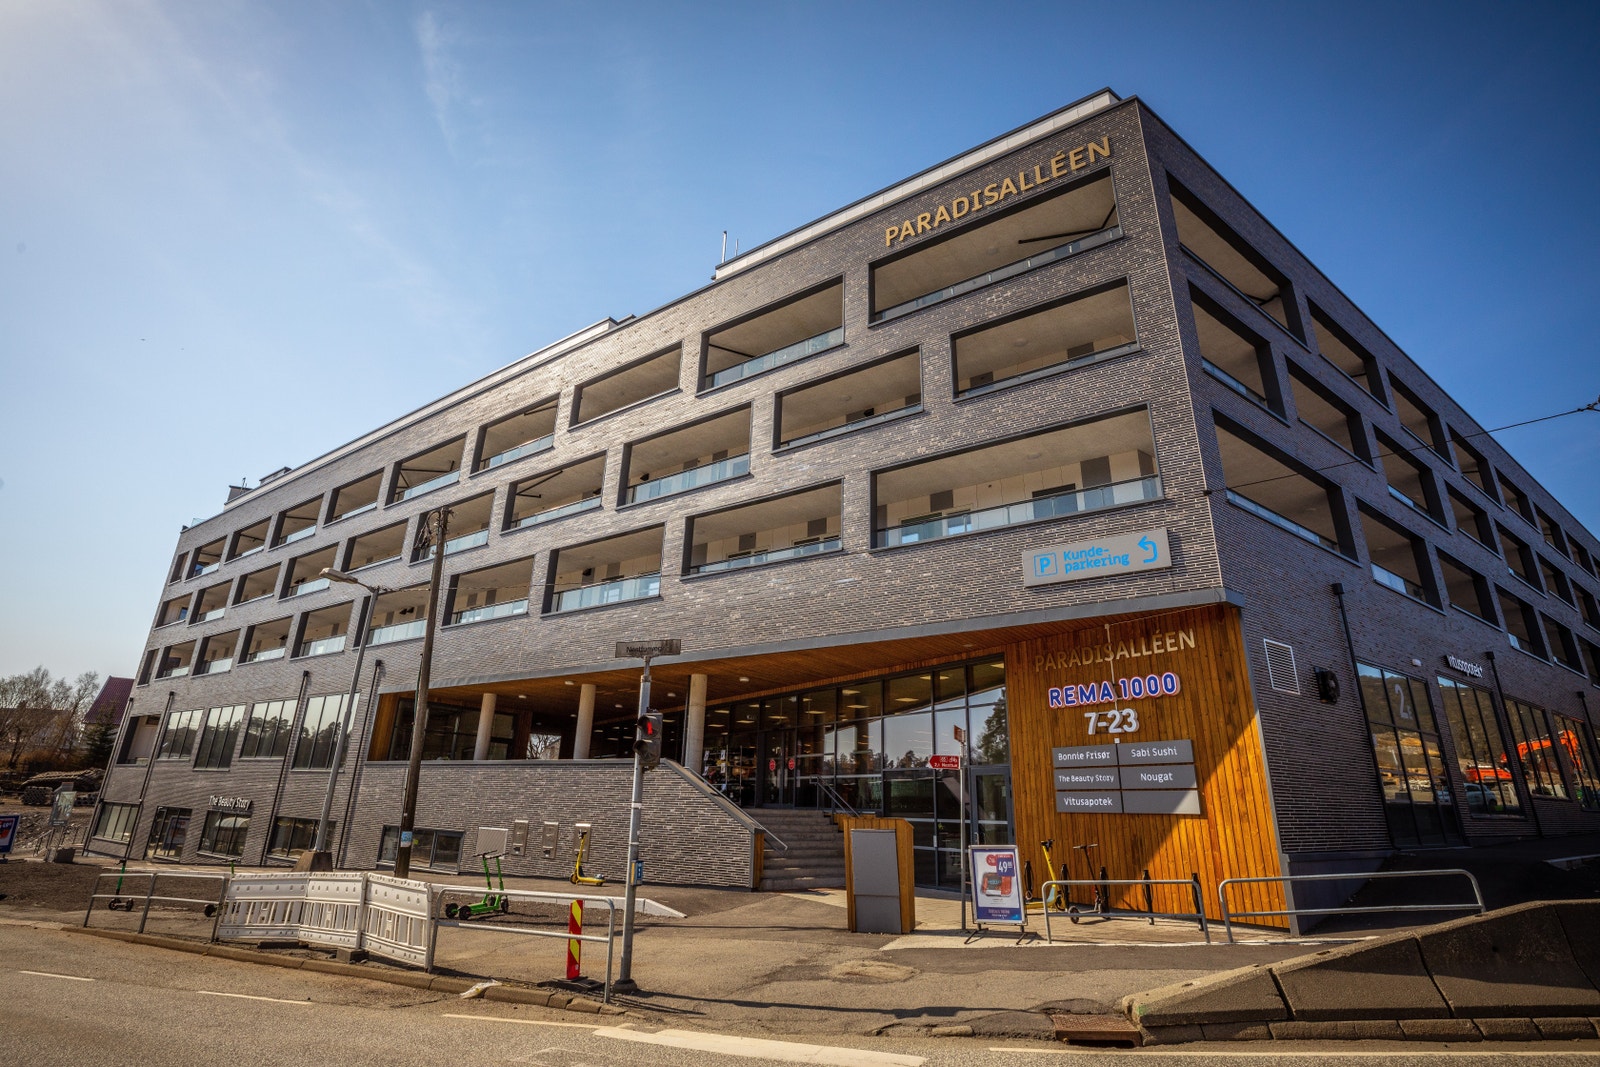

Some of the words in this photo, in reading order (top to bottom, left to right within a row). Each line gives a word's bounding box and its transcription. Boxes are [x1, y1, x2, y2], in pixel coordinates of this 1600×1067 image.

[885, 135, 1111, 247] PARADISALLÉEN
[1063, 546, 1110, 562] Kunde-
[1039, 557, 1051, 573] P
[1065, 553, 1130, 574] parkering
[1034, 628, 1196, 672] PARADISALLÉEN
[1048, 680, 1115, 709] REMA
[1118, 671, 1180, 700] 1000
[1084, 708, 1140, 735] 7-23
[1058, 752, 1084, 761] Bonnie
[1086, 751, 1110, 760] Frisør
[1131, 748, 1150, 758] Sabi
[1152, 746, 1178, 757] Sushi
[1070, 775, 1094, 783] Beauty
[1095, 774, 1114, 782] Story
[1140, 772, 1174, 783] Nougat
[208, 795, 218, 806] The
[218, 796, 236, 810] Beauty
[235, 797, 252, 811] Story
[1063, 797, 1113, 807] Vitusapotek
[998, 861, 1008, 873] 49
